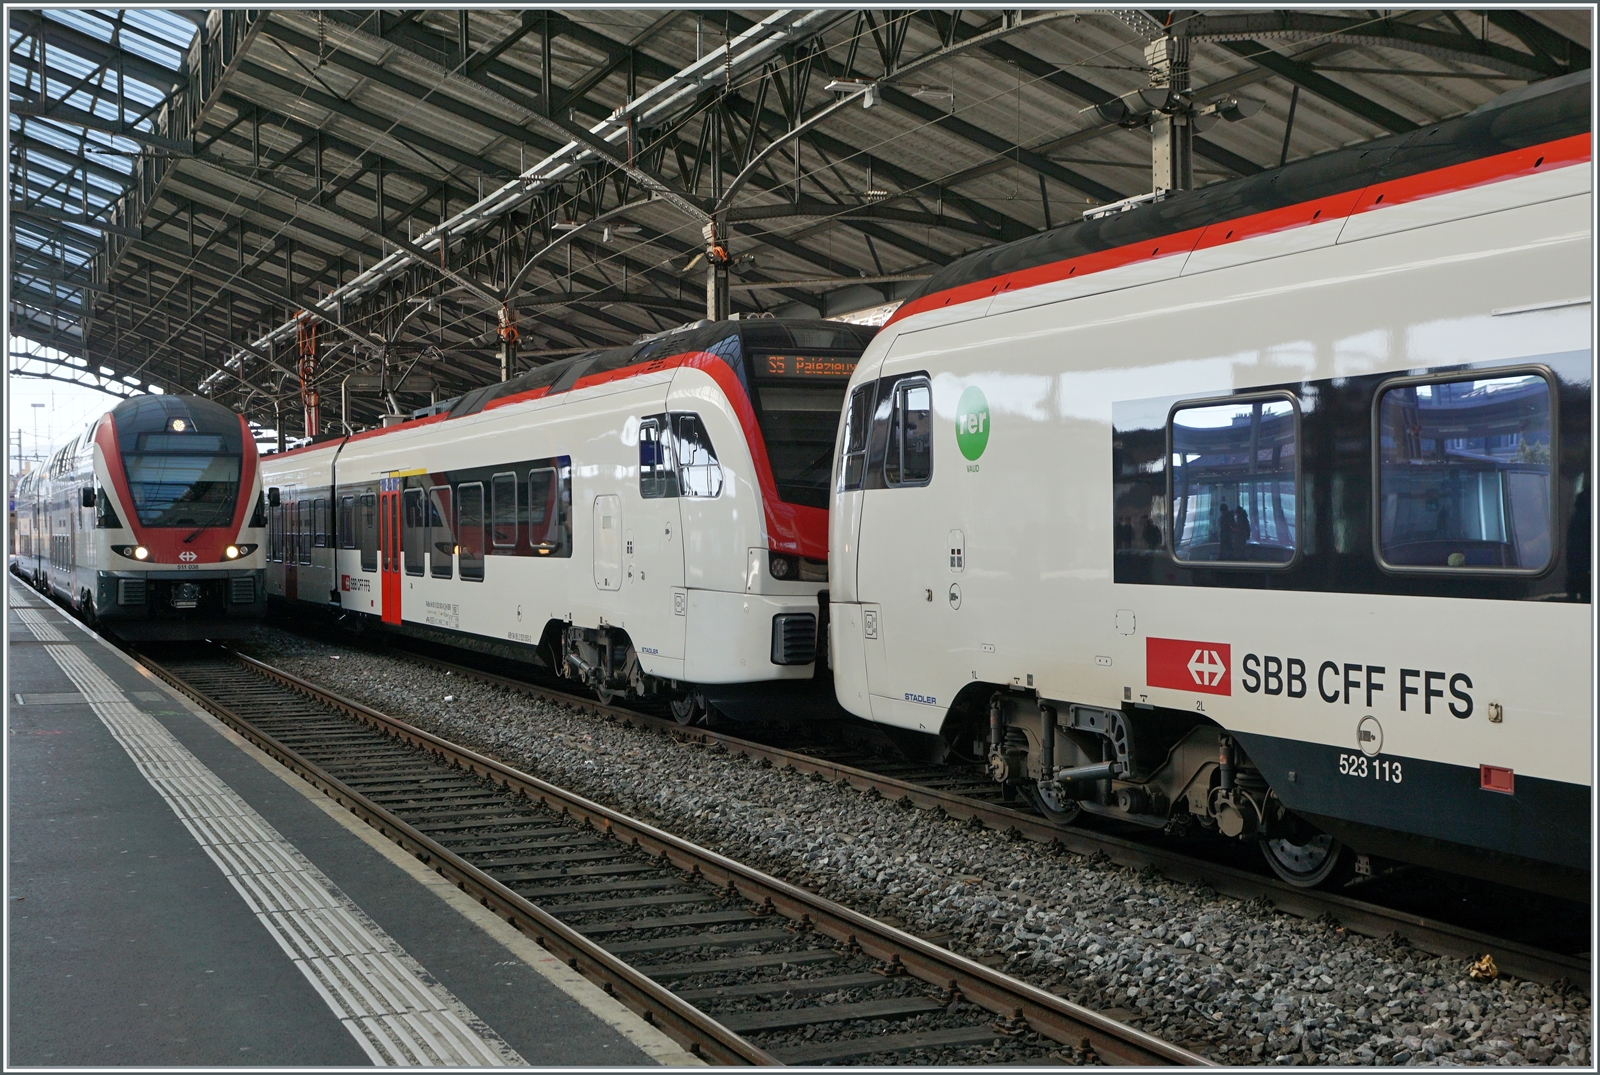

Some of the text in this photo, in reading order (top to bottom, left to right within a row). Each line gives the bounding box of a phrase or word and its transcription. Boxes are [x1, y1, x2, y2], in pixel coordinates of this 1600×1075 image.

[768, 356, 785, 374] S5
[960, 412, 986, 434] rer
[1242, 653, 1474, 719] SBB CFF FFS
[904, 692, 937, 704] STADLER
[1196, 700, 1205, 712] 2L
[1339, 754, 1402, 784] 523 113
